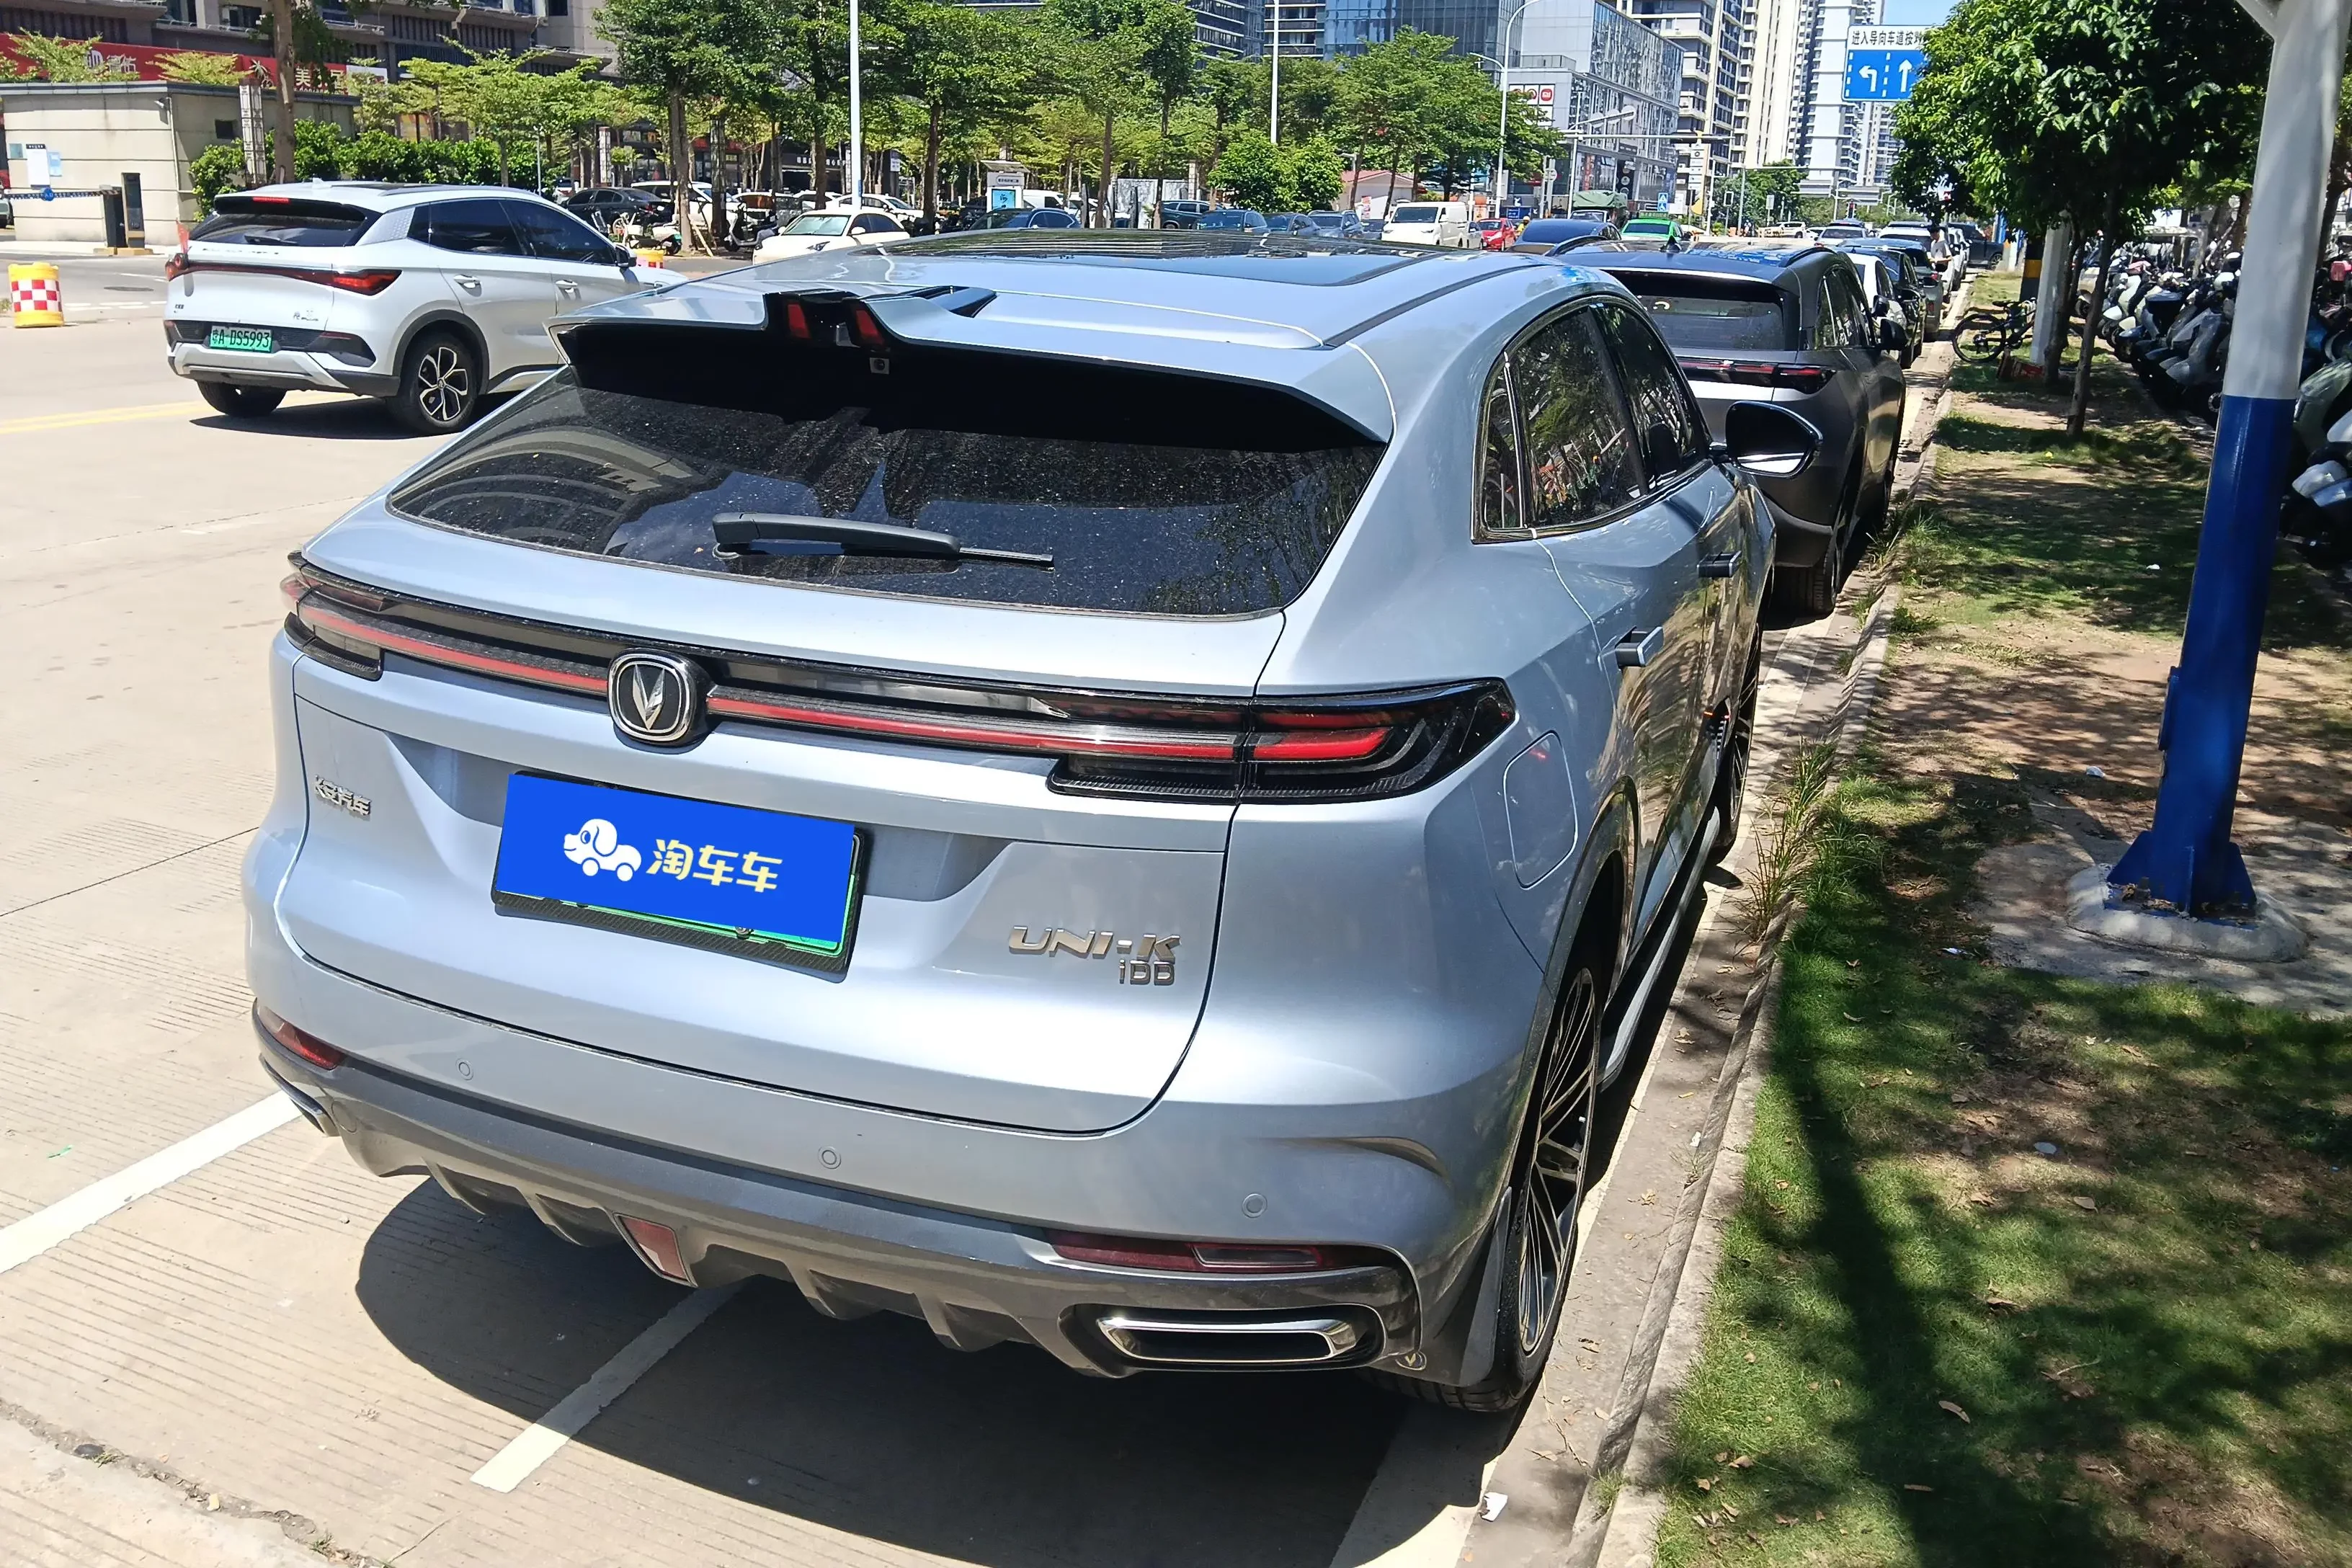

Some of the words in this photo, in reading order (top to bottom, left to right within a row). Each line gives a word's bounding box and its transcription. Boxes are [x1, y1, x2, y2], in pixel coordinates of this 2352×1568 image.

[315, 775, 372, 816] 长安汽车
[1008, 925, 1182, 963] UNI-K
